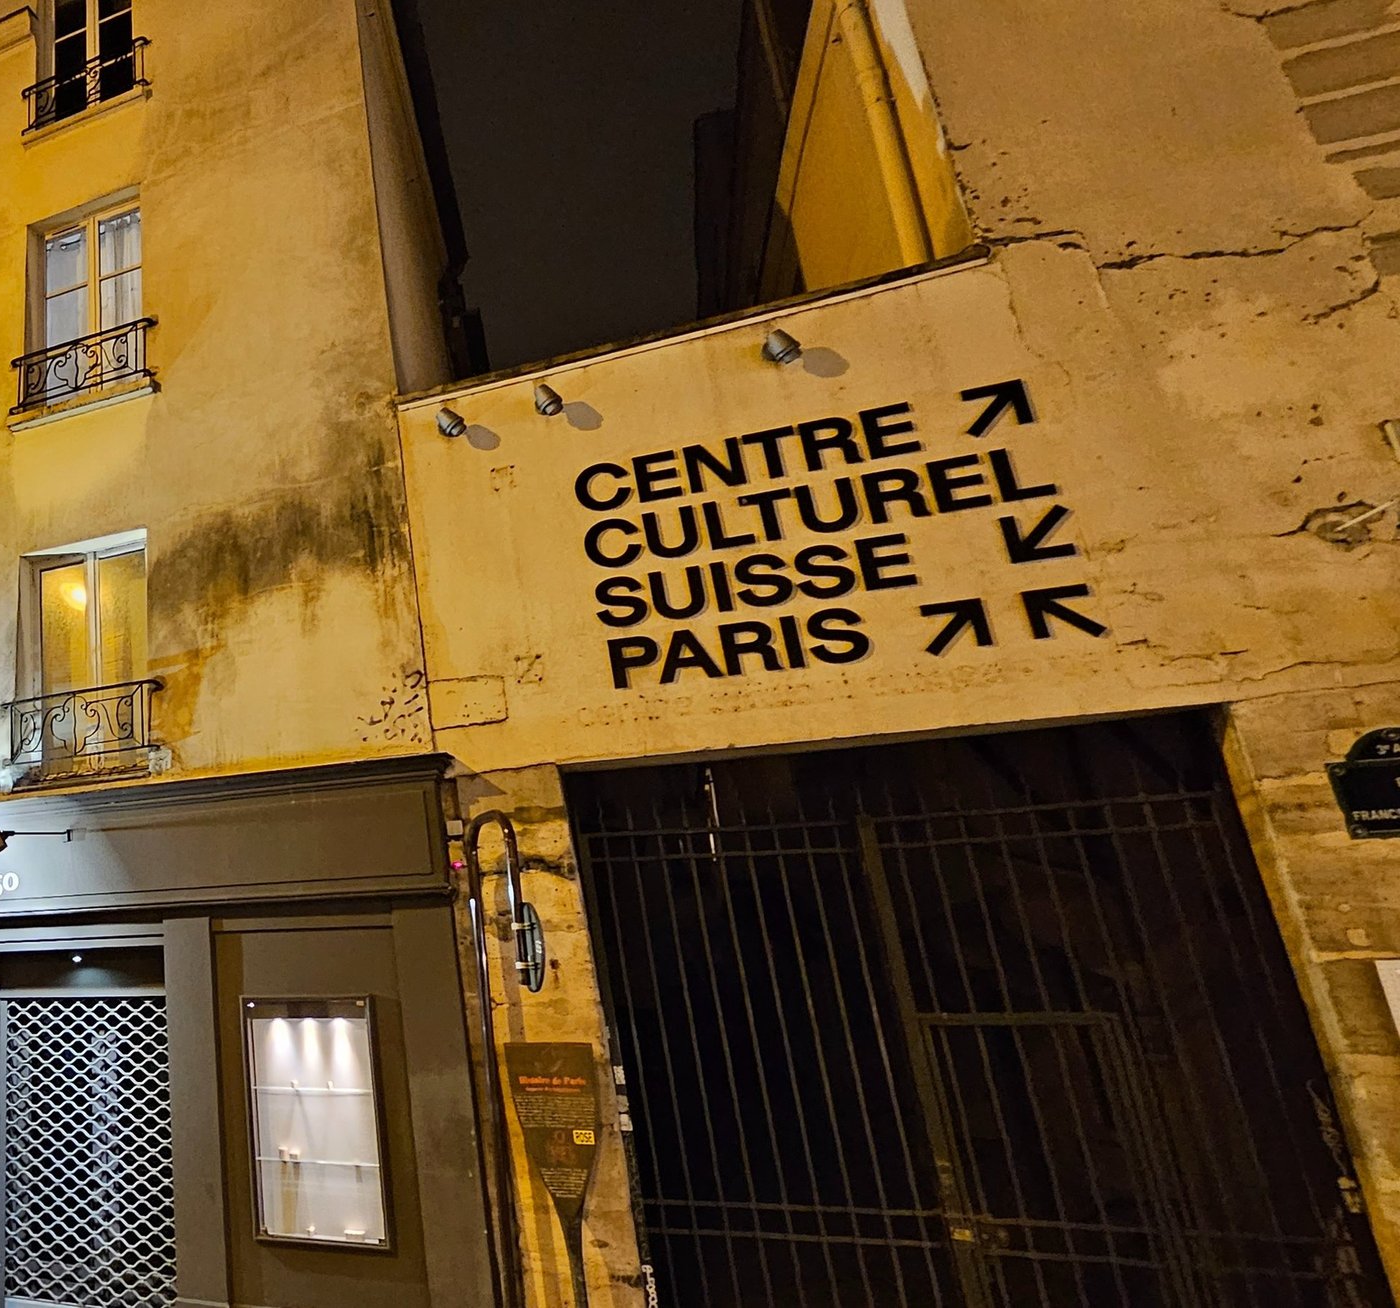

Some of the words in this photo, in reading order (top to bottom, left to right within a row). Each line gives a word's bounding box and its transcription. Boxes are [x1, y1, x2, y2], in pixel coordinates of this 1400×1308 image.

[575, 402, 922, 511] CENTRE
[583, 448, 1058, 568] CULTUREL
[595, 533, 918, 628] SUISSE
[607, 608, 871, 690] PARIS
